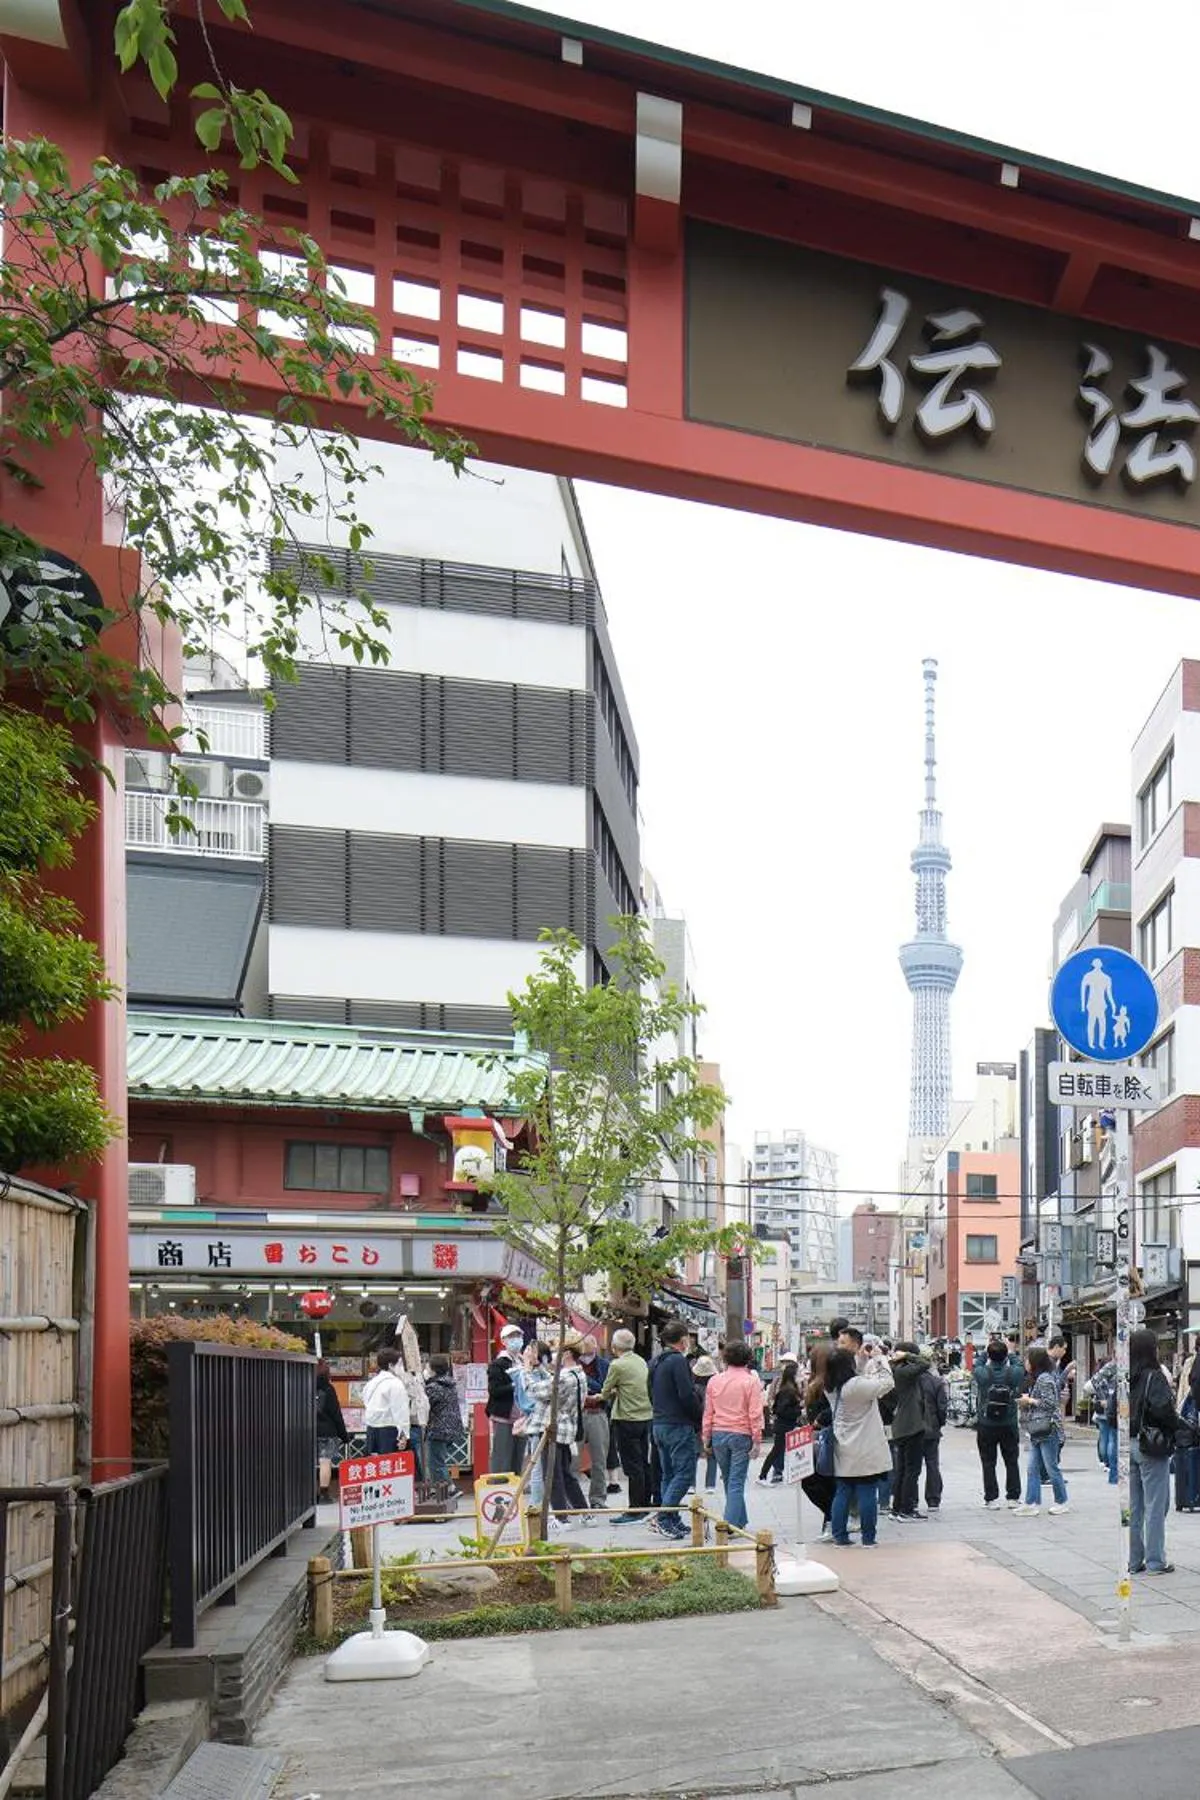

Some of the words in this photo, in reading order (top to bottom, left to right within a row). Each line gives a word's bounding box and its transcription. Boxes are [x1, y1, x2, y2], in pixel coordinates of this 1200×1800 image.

[1058, 1071, 1154, 1101] 自転車を除く
[157, 1240, 232, 1268] 商店
[264, 1243, 380, 1266] 雷おこし
[348, 1457, 407, 1481] 飲食禁止
